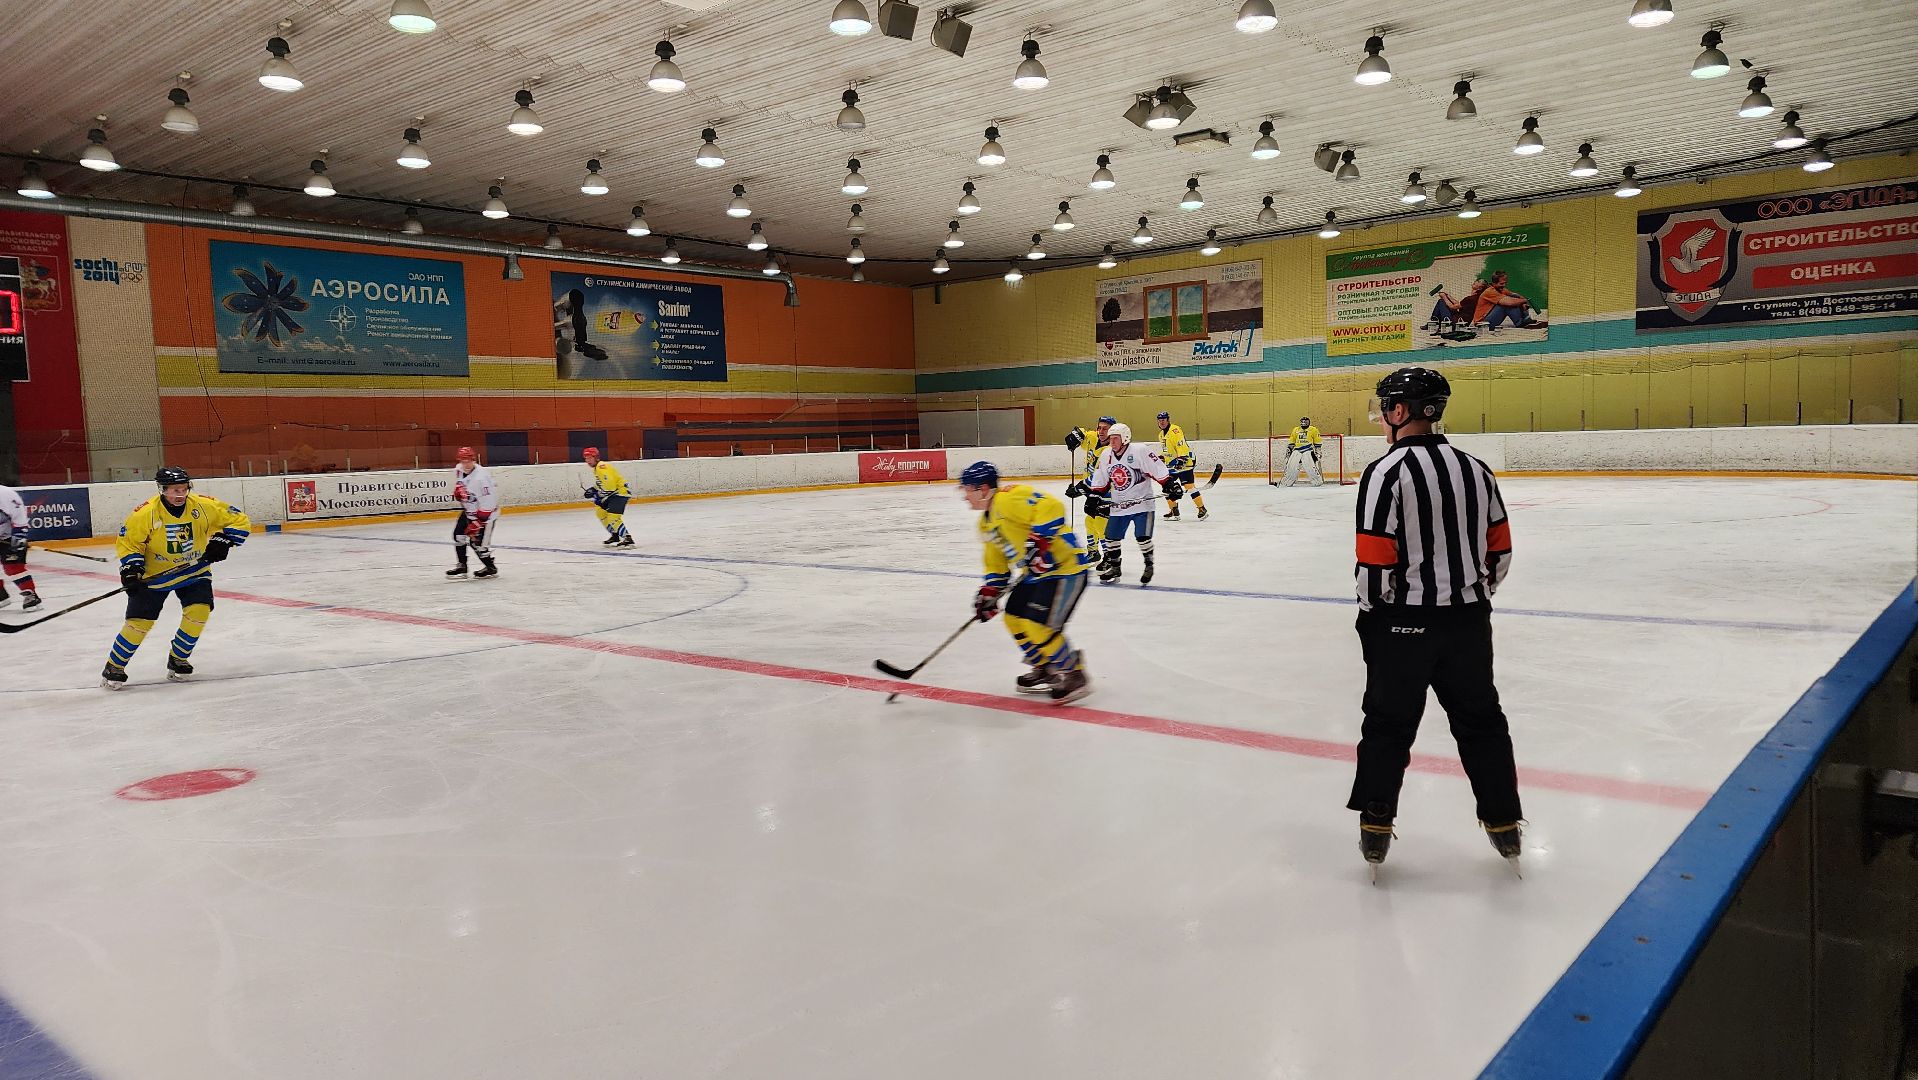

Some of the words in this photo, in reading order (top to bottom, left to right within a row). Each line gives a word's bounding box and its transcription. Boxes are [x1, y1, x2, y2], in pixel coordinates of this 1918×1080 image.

[1757, 197, 1814, 219] ООО
[1448, 240, 1477, 252] 8(496)
[1479, 233, 1528, 248] 642-72-72
[1790, 260, 1876, 281] ОЦЕНКА
[83, 270, 120, 286] 2014
[427, 274, 444, 283] НПП
[1337, 275, 1422, 292] СТРОИТЕЛЬСТВО
[311, 278, 450, 305] АЭРОСИЛА
[673, 285, 693, 294] ЗАВОД
[1337, 291, 1381, 301] РОЗНИЧНАЯ
[1373, 304, 1413, 313] ПОСТАВКИ
[1804, 299, 1820, 309] ул.
[1798, 305, 1832, 318] 8(496)
[1332, 323, 1406, 337] www.cmix.ru
[1101, 355, 1160, 368] www.plastok.ru
[338, 480, 448, 496] Правительство
[318, 494, 409, 511] Московской
[412, 493, 457, 505] област
[1391, 625, 1426, 635] CCM
